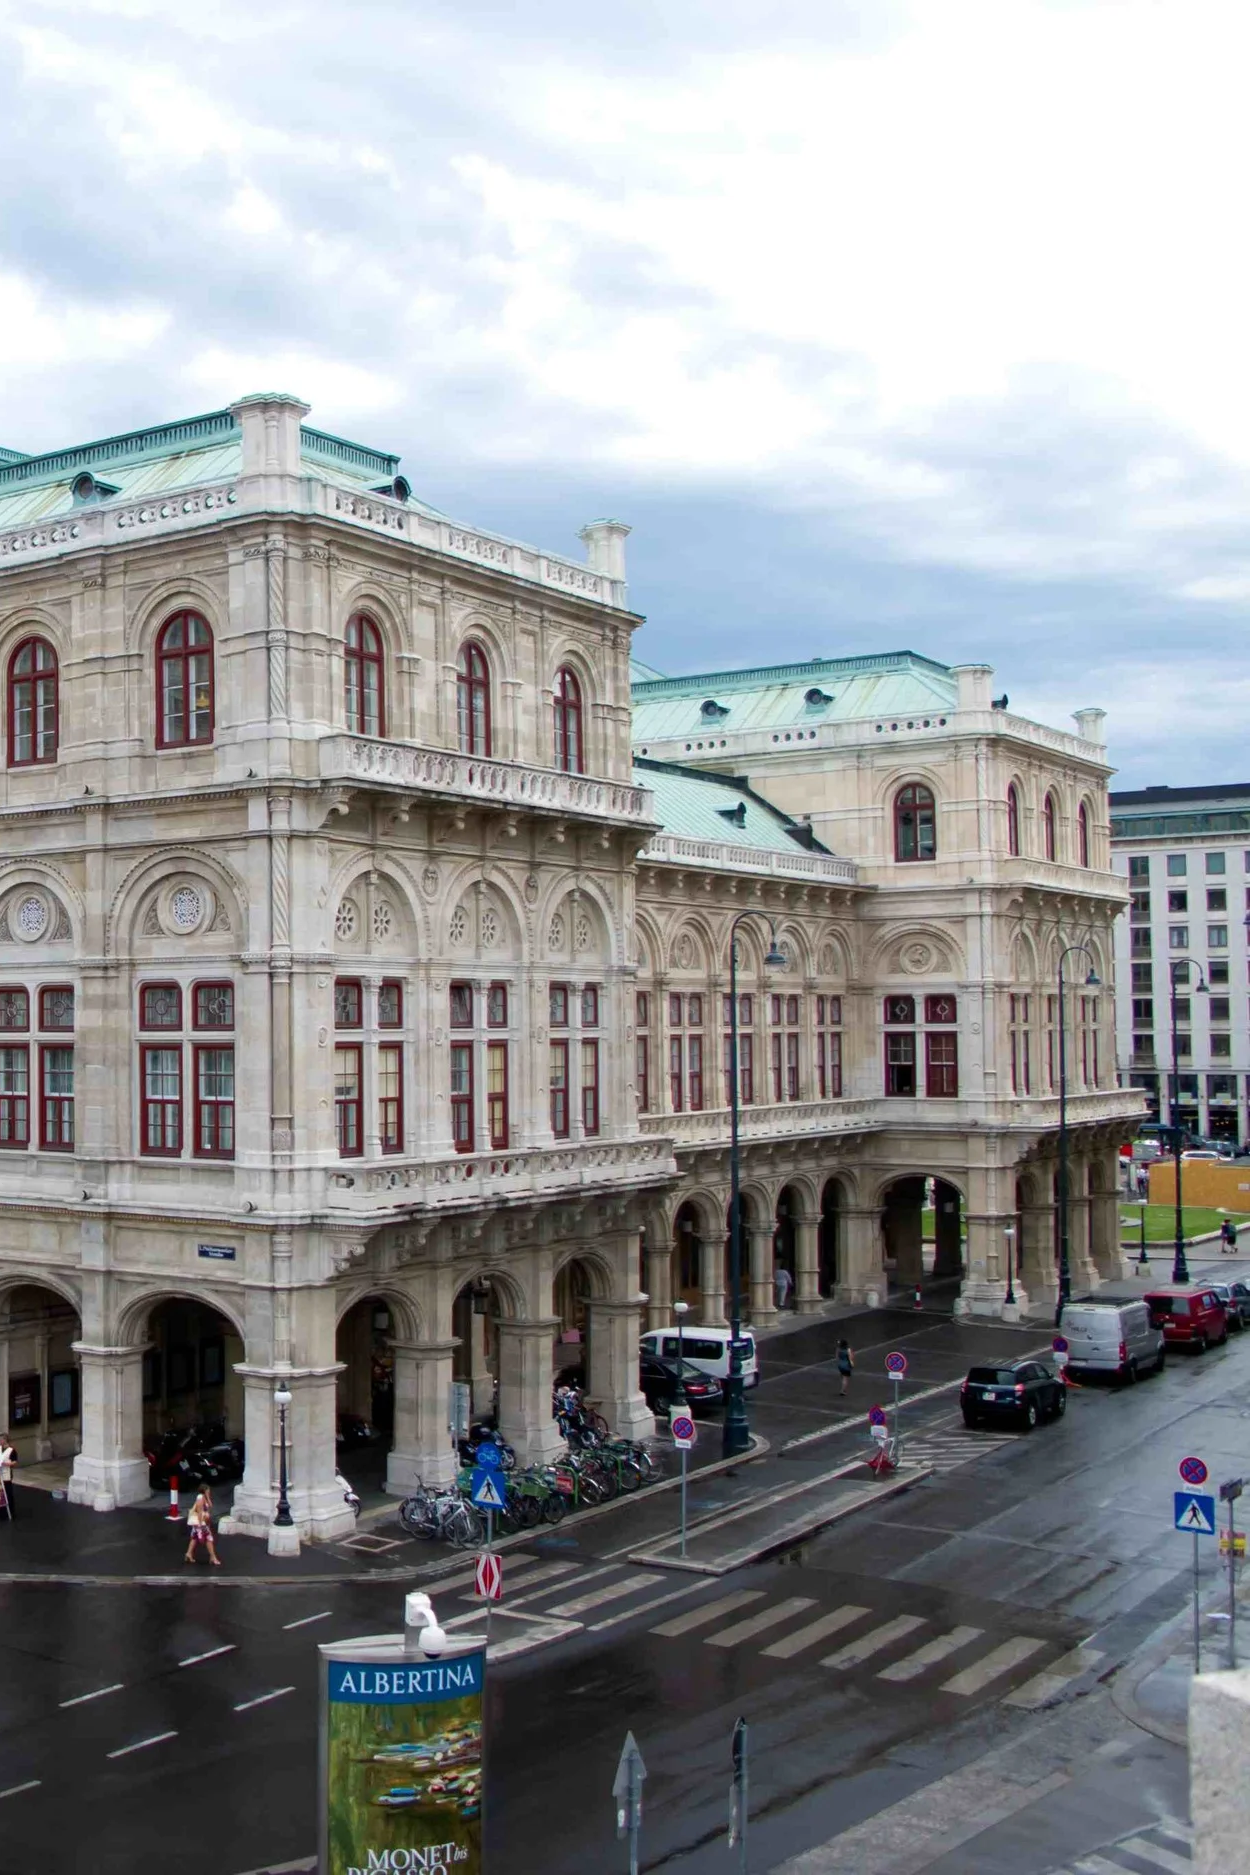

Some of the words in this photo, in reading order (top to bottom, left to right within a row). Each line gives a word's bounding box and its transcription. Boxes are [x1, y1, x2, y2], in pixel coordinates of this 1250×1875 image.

[339, 1664, 475, 1694] ALBERTINA
[367, 1842, 455, 1869] MONET
[454, 1845, 468, 1860] bis
